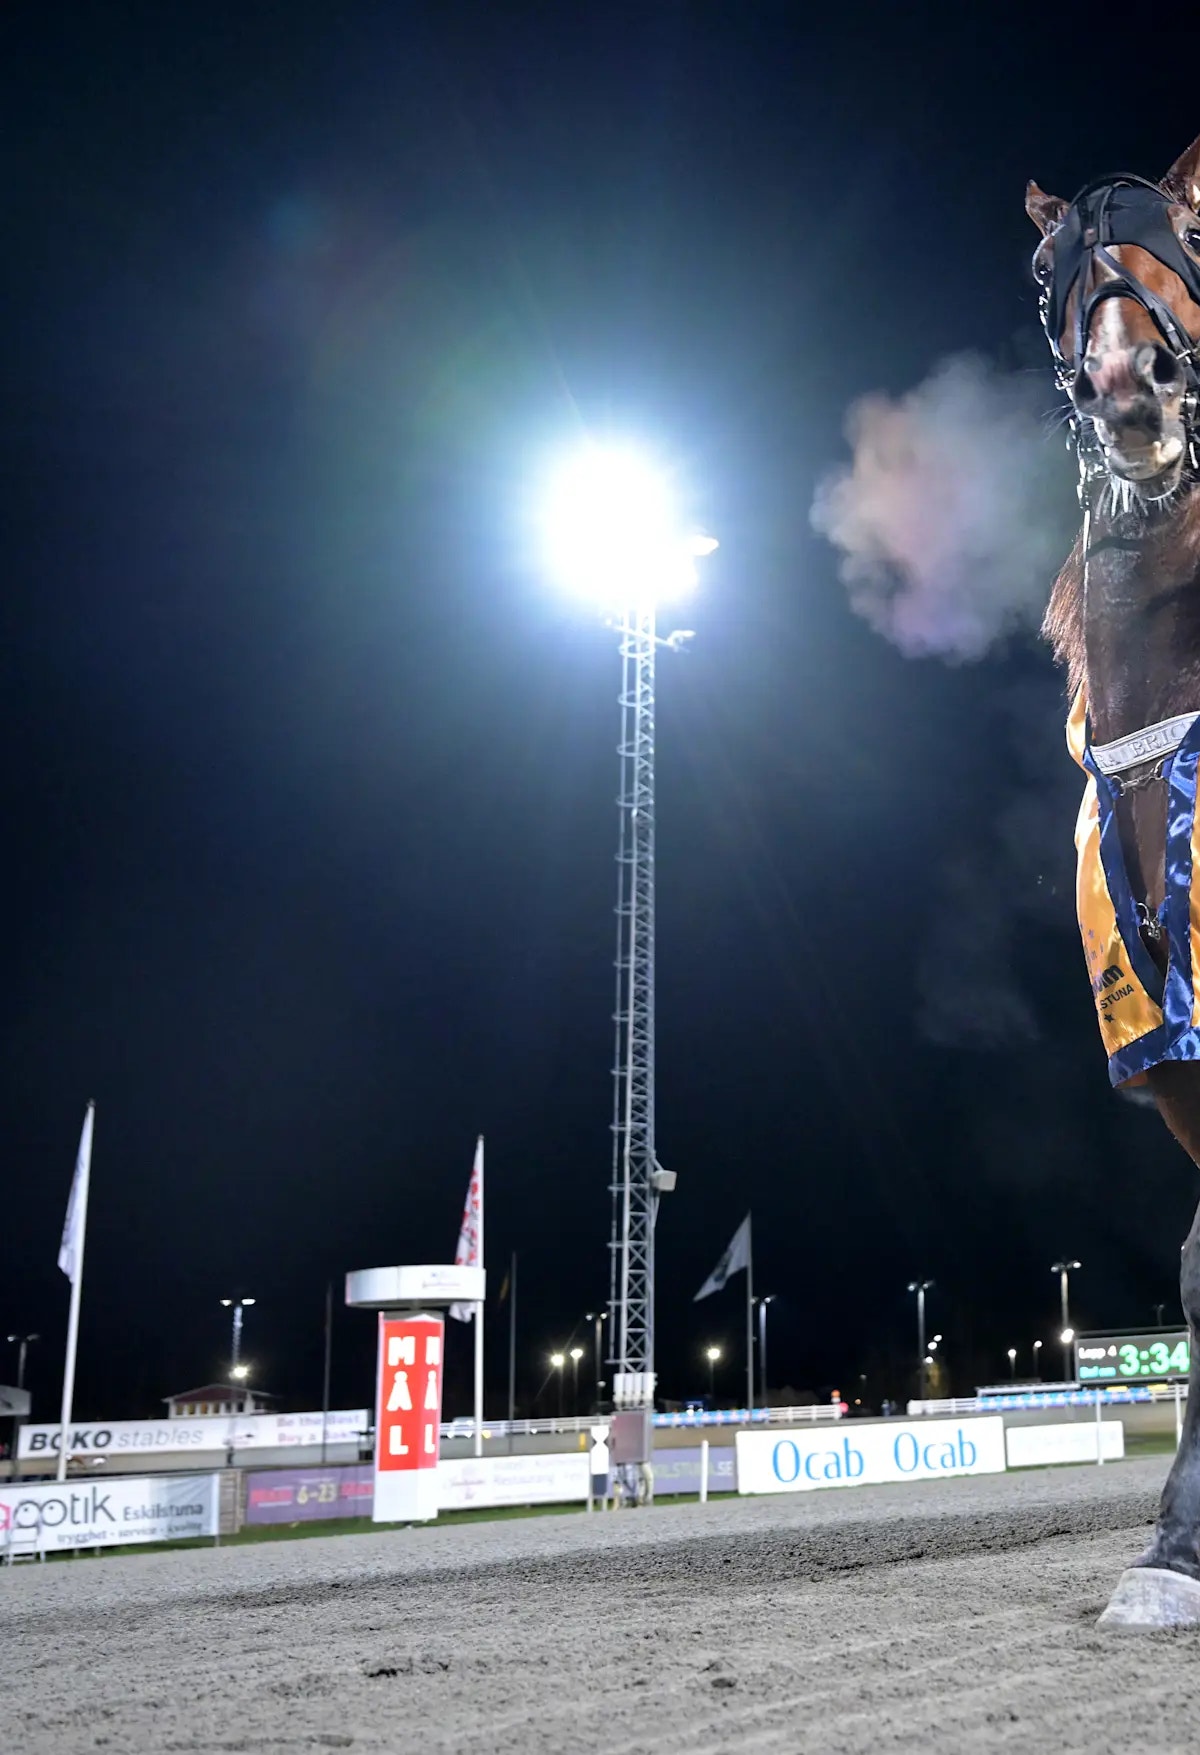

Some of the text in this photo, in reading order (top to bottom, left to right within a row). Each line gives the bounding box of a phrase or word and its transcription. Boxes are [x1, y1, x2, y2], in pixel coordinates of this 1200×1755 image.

[1127, 721, 1192, 758] BRIC
[1100, 983, 1135, 1010] STUNA
[1119, 1341, 1190, 1377] 3:34
[386, 1336, 416, 1456] MÅL
[30, 1430, 112, 1451] BOKO
[118, 1428, 203, 1448] stables
[772, 1436, 864, 1483] Ocab
[893, 1428, 977, 1473] Ocab
[123, 1501, 204, 1522] Eskilstuna
